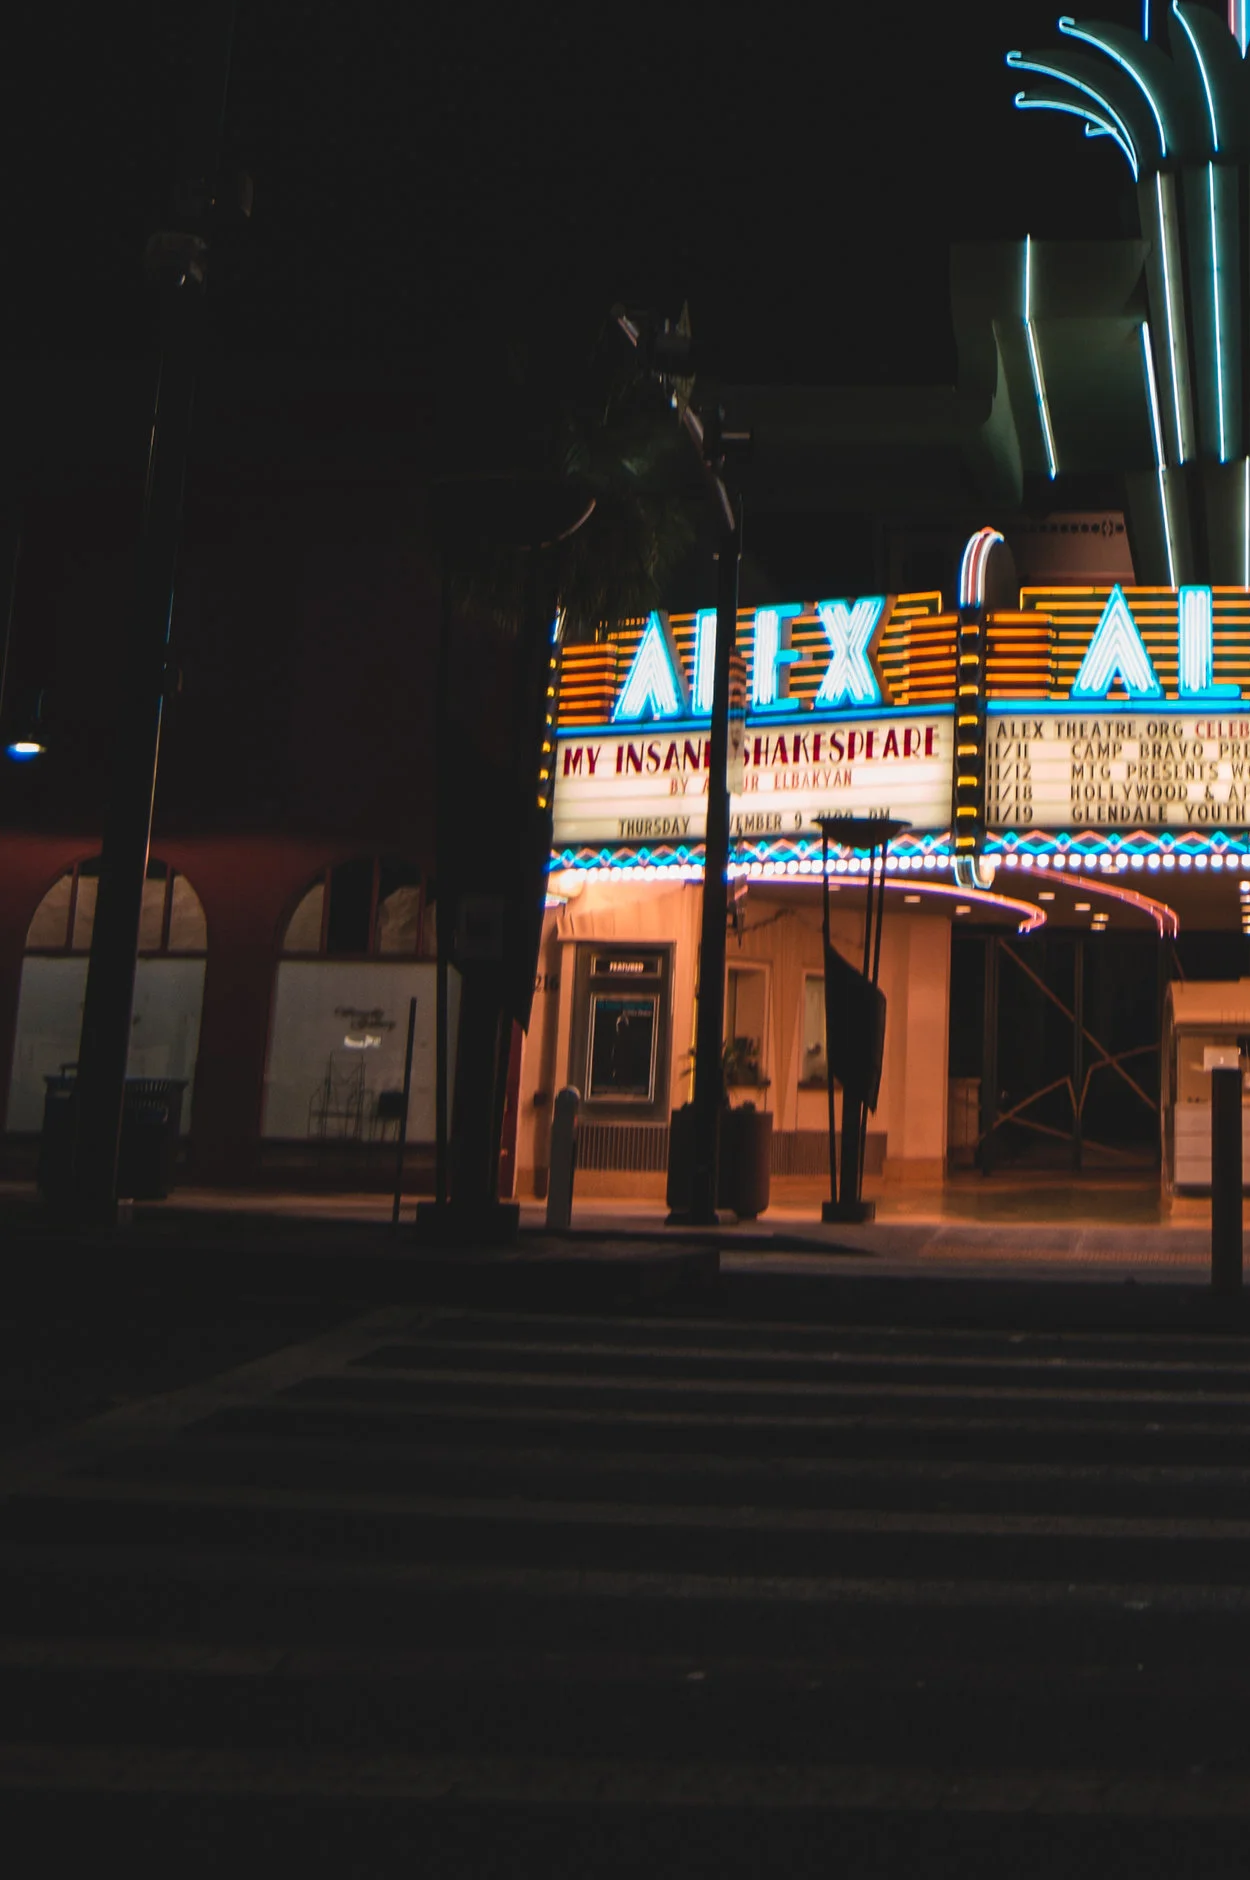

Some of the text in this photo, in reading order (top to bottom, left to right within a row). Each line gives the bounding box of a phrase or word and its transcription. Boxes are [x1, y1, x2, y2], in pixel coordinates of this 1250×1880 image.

[996, 720, 1044, 740] ALEX
[563, 744, 603, 777] MY
[987, 742, 1029, 760] 11/11
[1071, 741, 1123, 760] CAMP
[1139, 741, 1204, 760] BRAVO
[987, 762, 1032, 780] 11/12
[1071, 762, 1112, 781] MTG
[1127, 762, 1219, 781] PRESENTS
[669, 774, 689, 796] BY
[1070, 783, 1189, 802] HOLLYWOOD
[1204, 784, 1215, 801] &
[986, 802, 1034, 823] 11/19
[1071, 803, 1168, 823] GLENDALE
[1184, 803, 1247, 823] YOUTH
[618, 816, 691, 838] THURSDAY
[793, 810, 803, 831] 9
